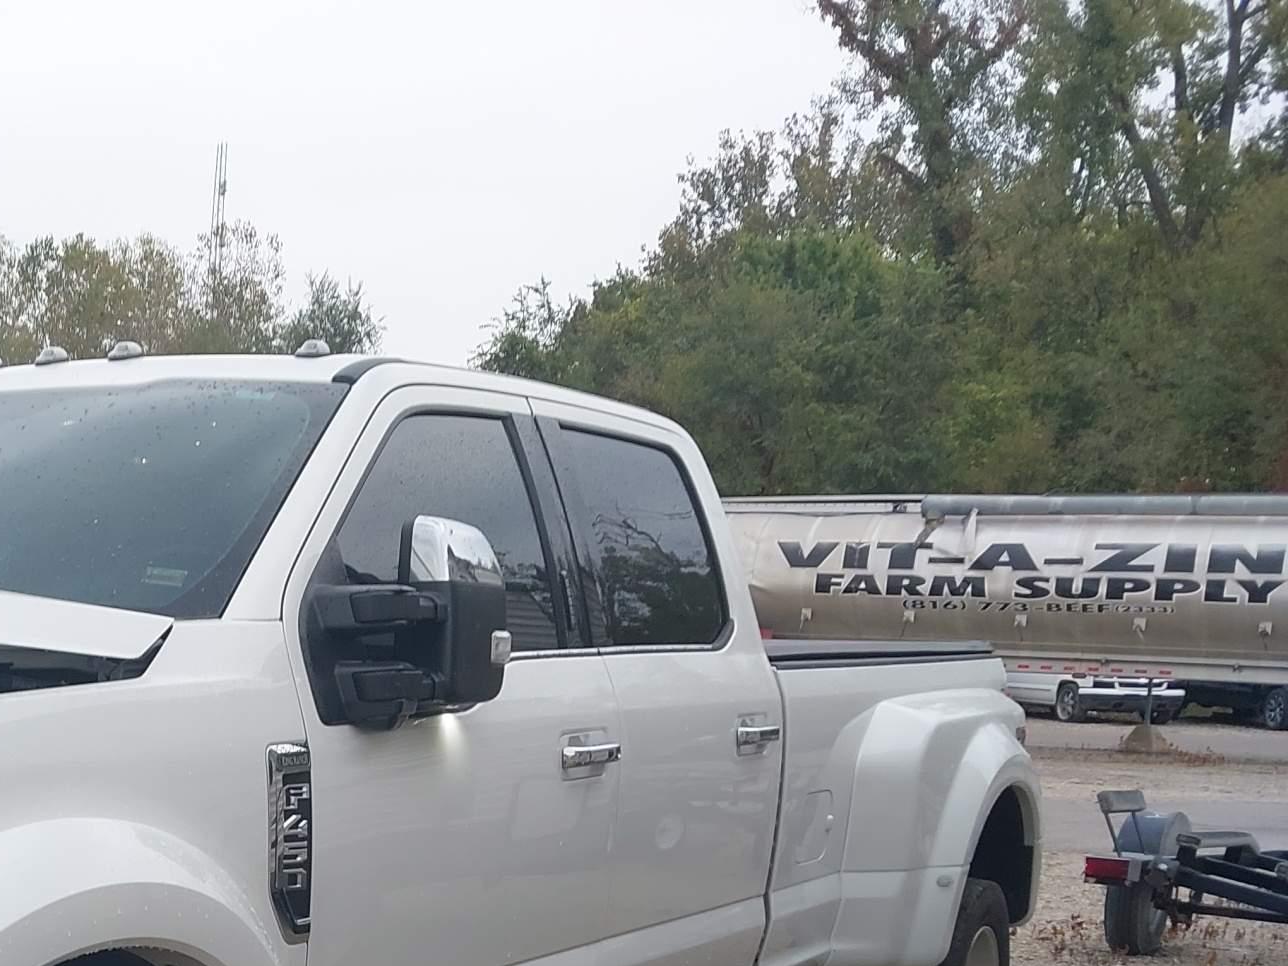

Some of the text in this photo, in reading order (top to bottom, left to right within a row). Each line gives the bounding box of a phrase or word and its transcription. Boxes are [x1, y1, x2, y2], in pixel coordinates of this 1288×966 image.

[814, 573, 1286, 604] FARM SUPPLY
[902, 600, 967, 611] (816)
